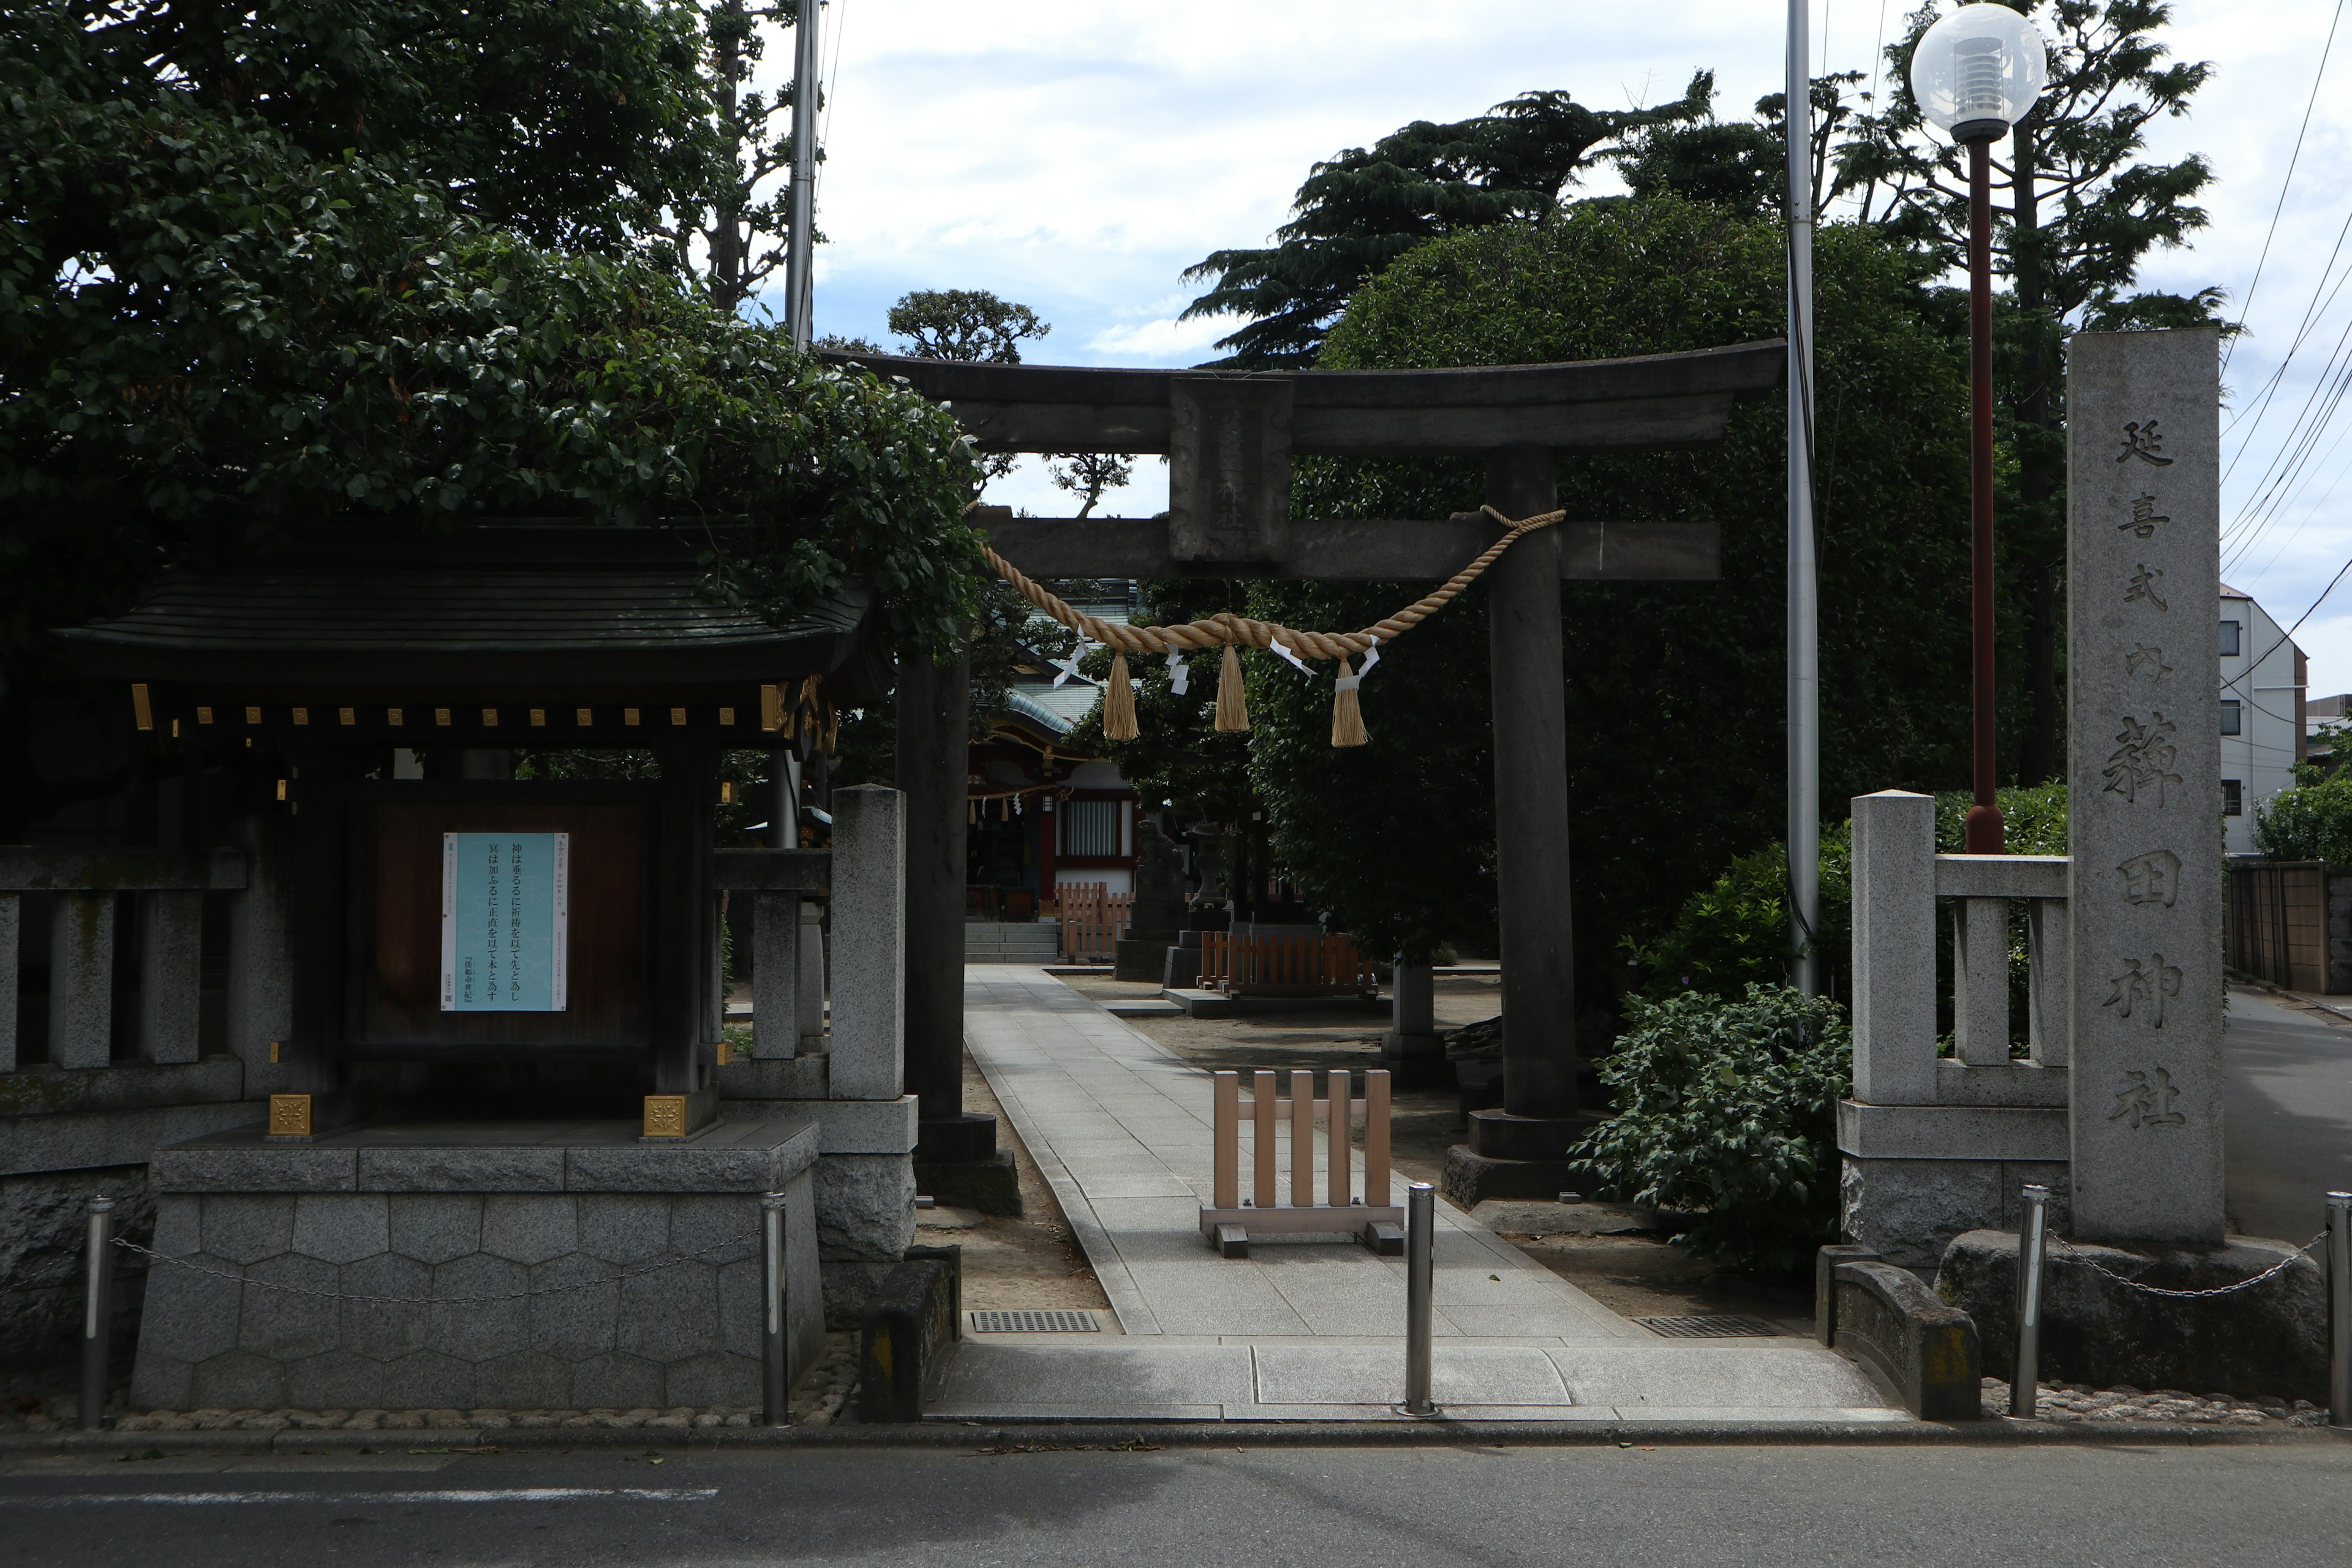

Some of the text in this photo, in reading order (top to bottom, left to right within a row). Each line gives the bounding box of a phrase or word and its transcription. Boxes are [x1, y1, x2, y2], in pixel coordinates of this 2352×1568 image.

[488, 843, 499, 1001] 冥は加ふるに正直を以て本と為す
[511, 843, 522, 1001] 神は垂るるに祈祷を以て先と為し
